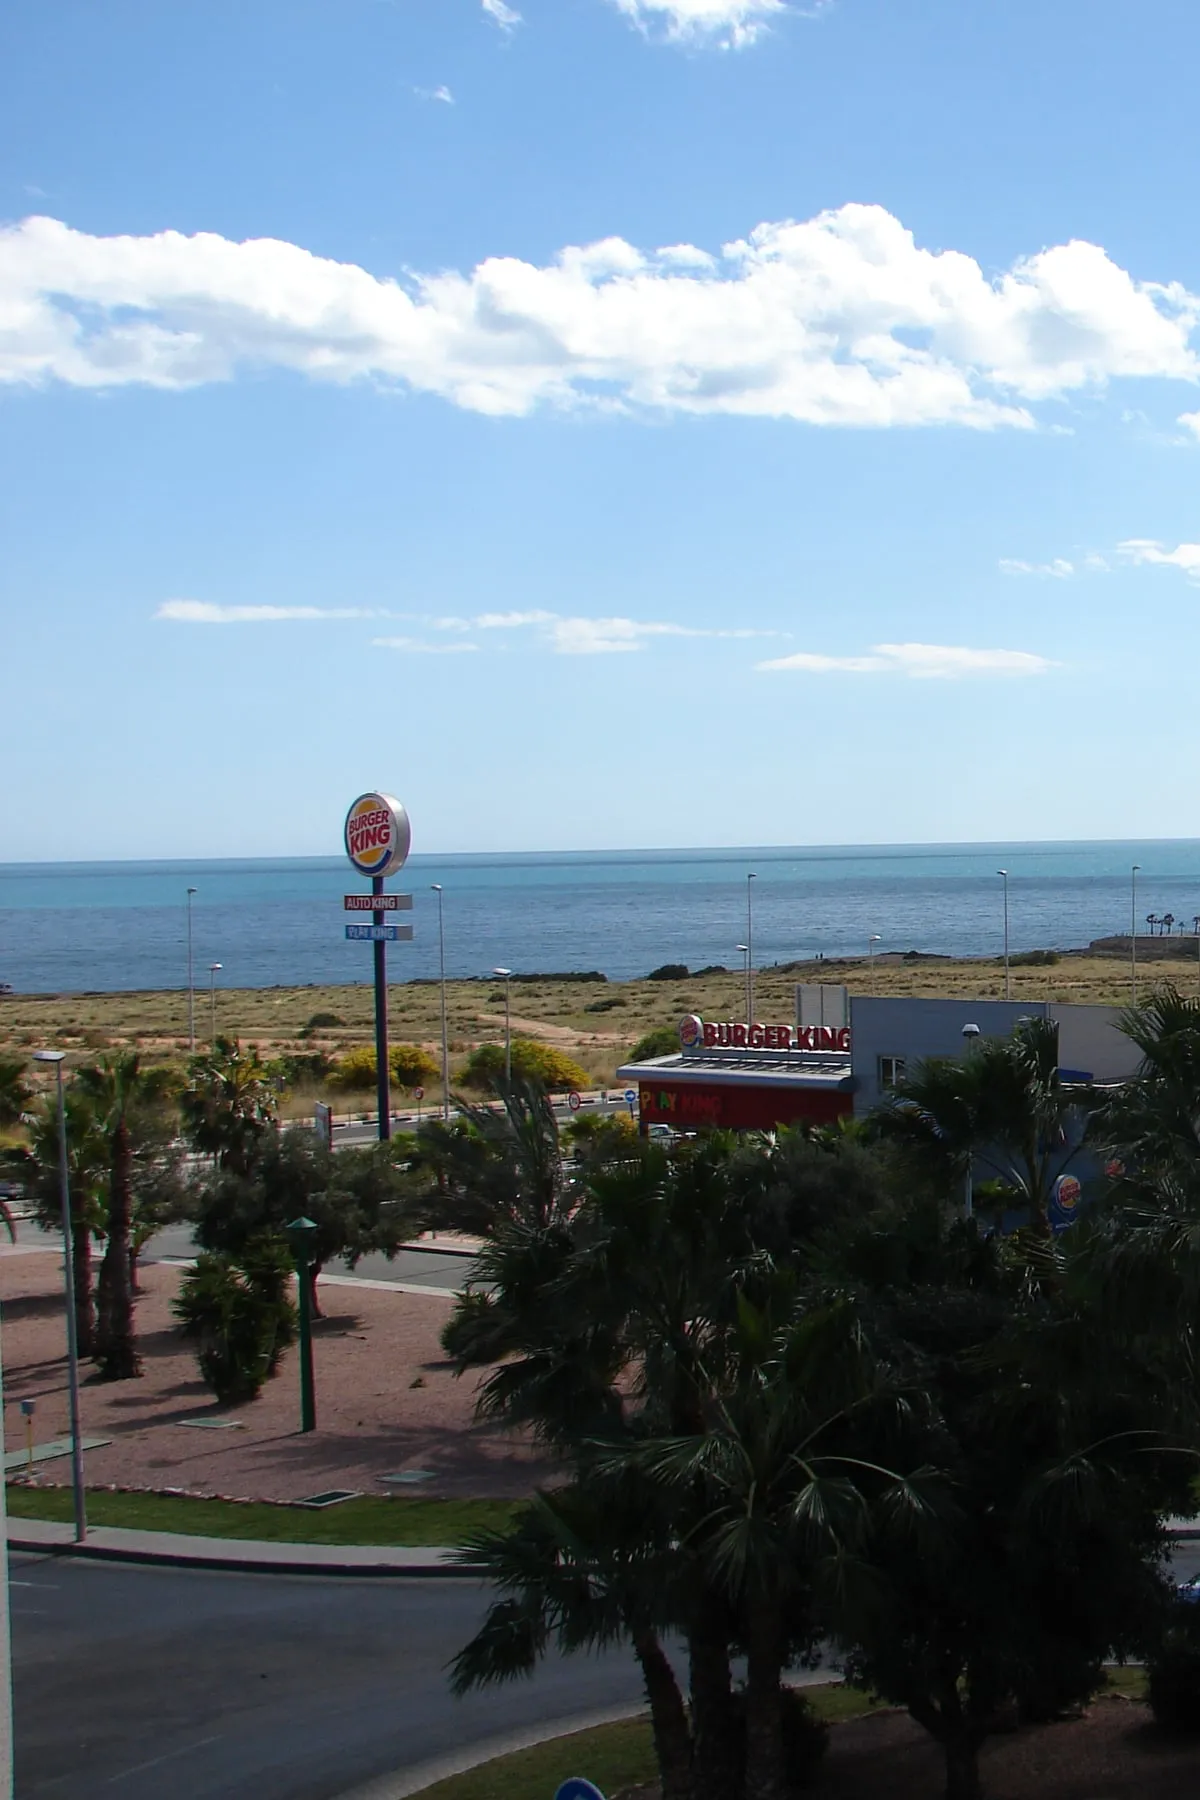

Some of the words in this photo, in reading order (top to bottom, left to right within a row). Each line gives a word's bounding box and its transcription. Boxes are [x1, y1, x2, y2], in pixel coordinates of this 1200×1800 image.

[349, 810, 390, 836] BURGER
[350, 823, 390, 855] KING
[347, 897, 371, 909] AUTO
[371, 897, 396, 909] KING
[703, 1021, 793, 1049] BURGER
[796, 1025, 850, 1051] KING
